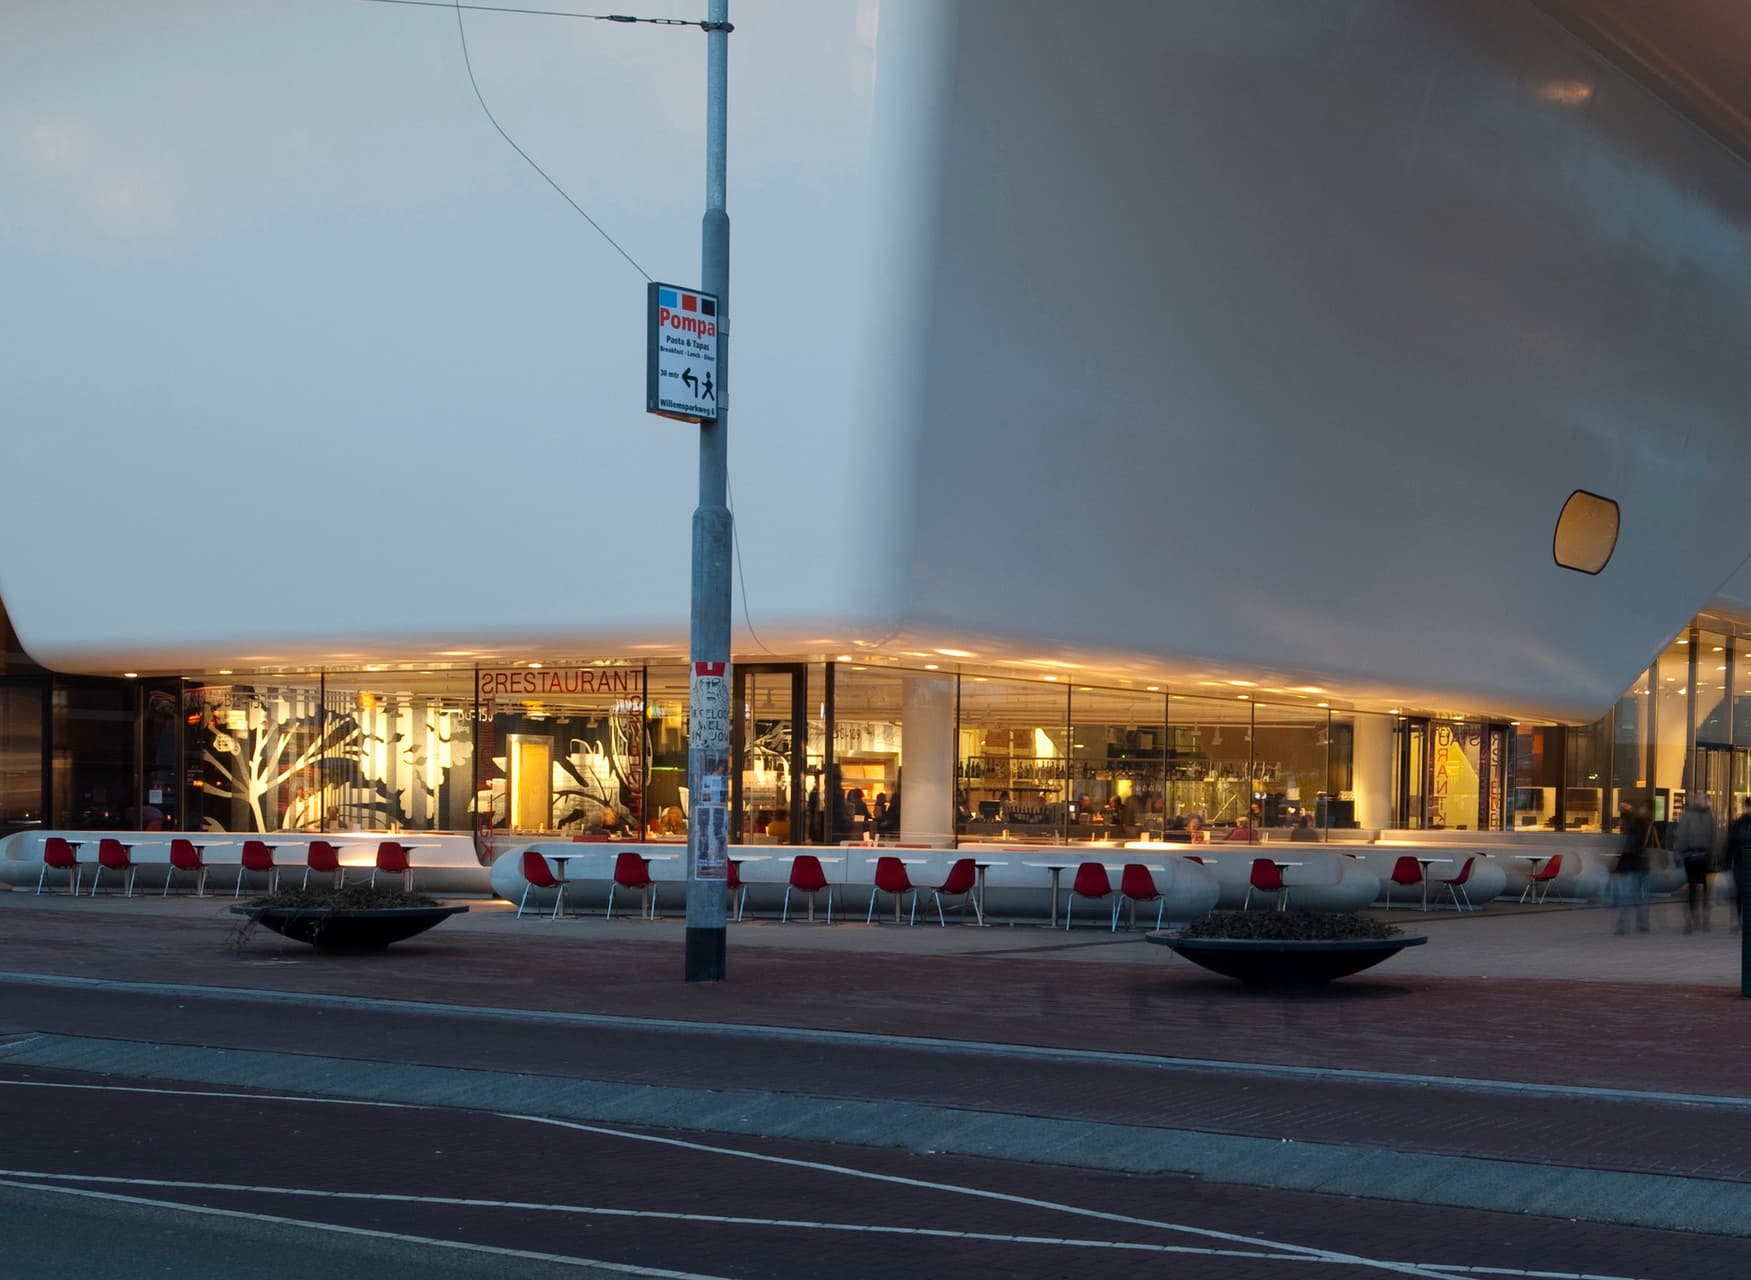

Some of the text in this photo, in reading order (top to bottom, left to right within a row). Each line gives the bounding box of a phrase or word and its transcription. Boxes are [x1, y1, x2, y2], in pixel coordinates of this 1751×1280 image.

[659, 307, 715, 339] Pompa
[666, 335, 685, 346] Pasta
[693, 340, 710, 351] Tapas
[495, 670, 642, 694] RESTAURANT
